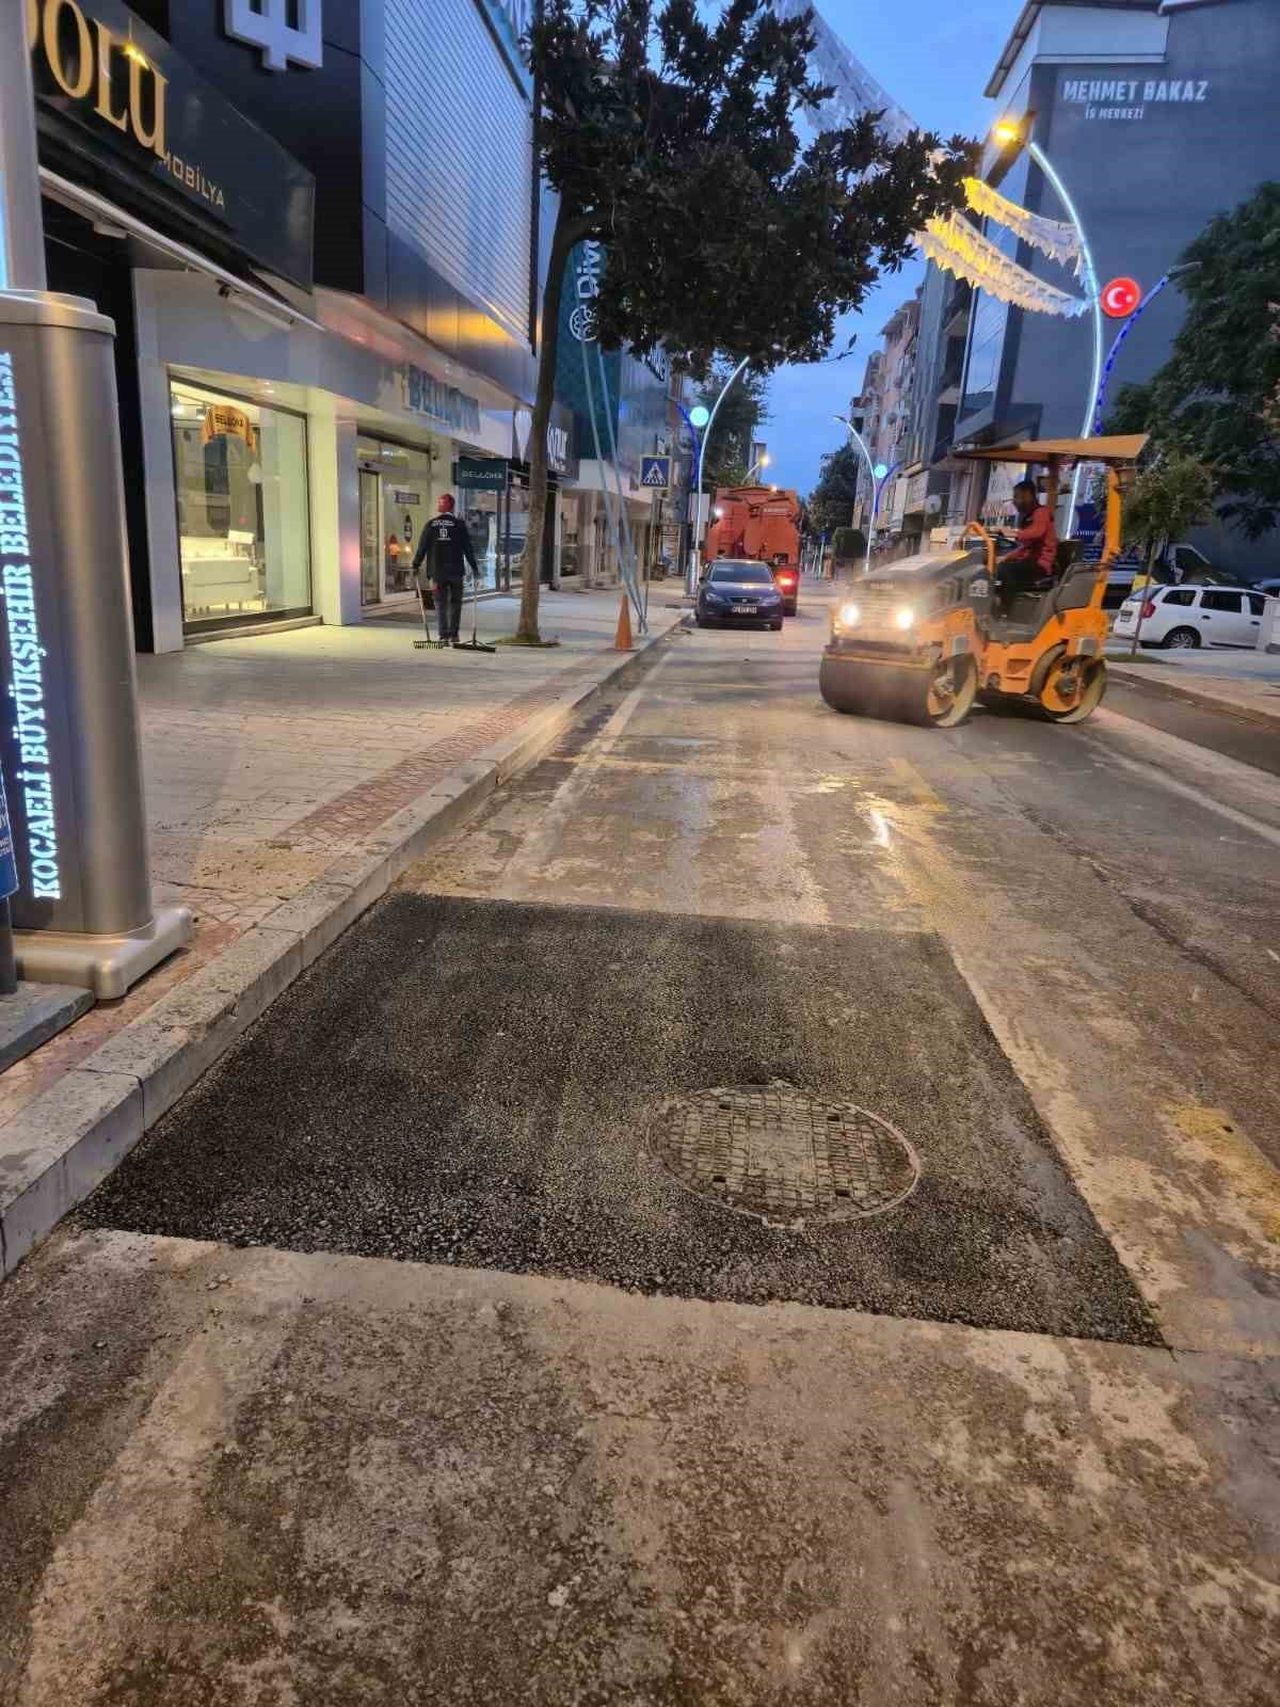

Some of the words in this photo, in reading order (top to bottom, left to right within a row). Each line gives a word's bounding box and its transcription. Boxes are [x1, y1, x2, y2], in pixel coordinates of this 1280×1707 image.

[1062, 79, 1140, 102] MEHMET
[0, 563, 50, 765] BÜYÜKŞEHİR
[15, 771, 61, 900] KOCAELİ
